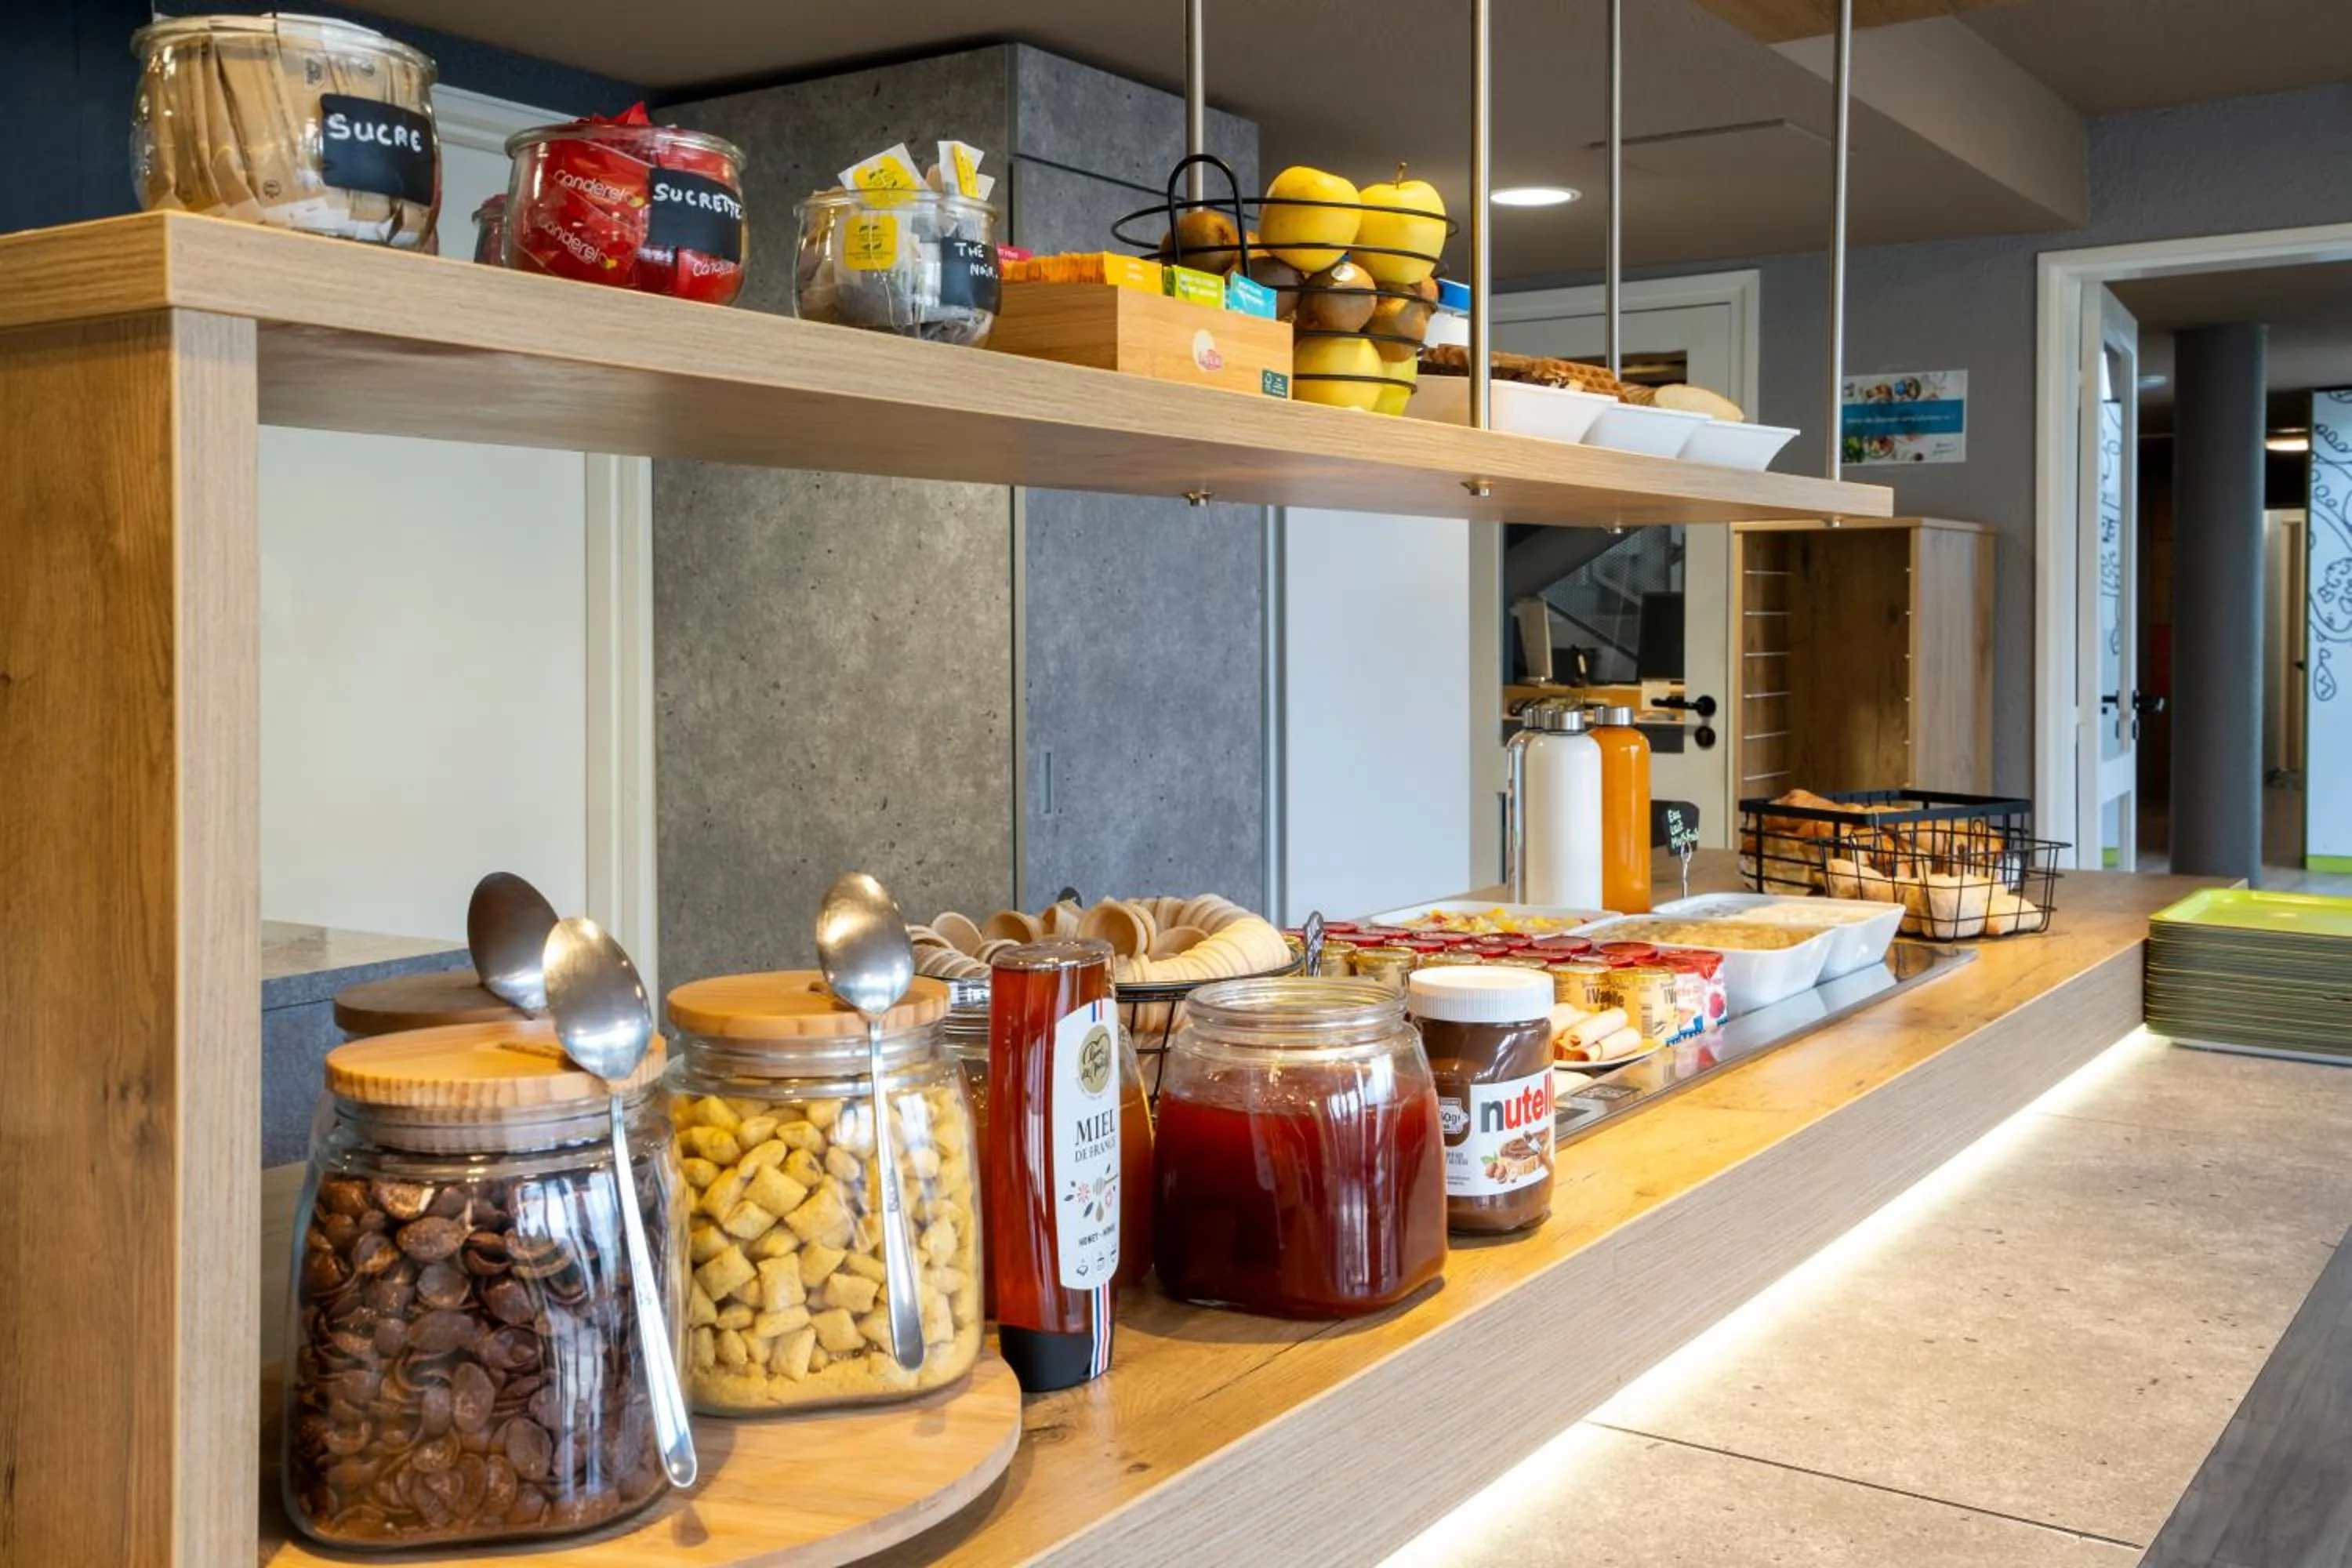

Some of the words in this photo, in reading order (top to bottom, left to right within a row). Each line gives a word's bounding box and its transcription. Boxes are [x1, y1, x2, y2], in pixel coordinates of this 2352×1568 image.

[328, 113, 422, 151] SUCRE
[1480, 1072, 1554, 1132] nutell
[1075, 1108, 1114, 1145] MIEL
[1075, 1148, 1087, 1163] DE
